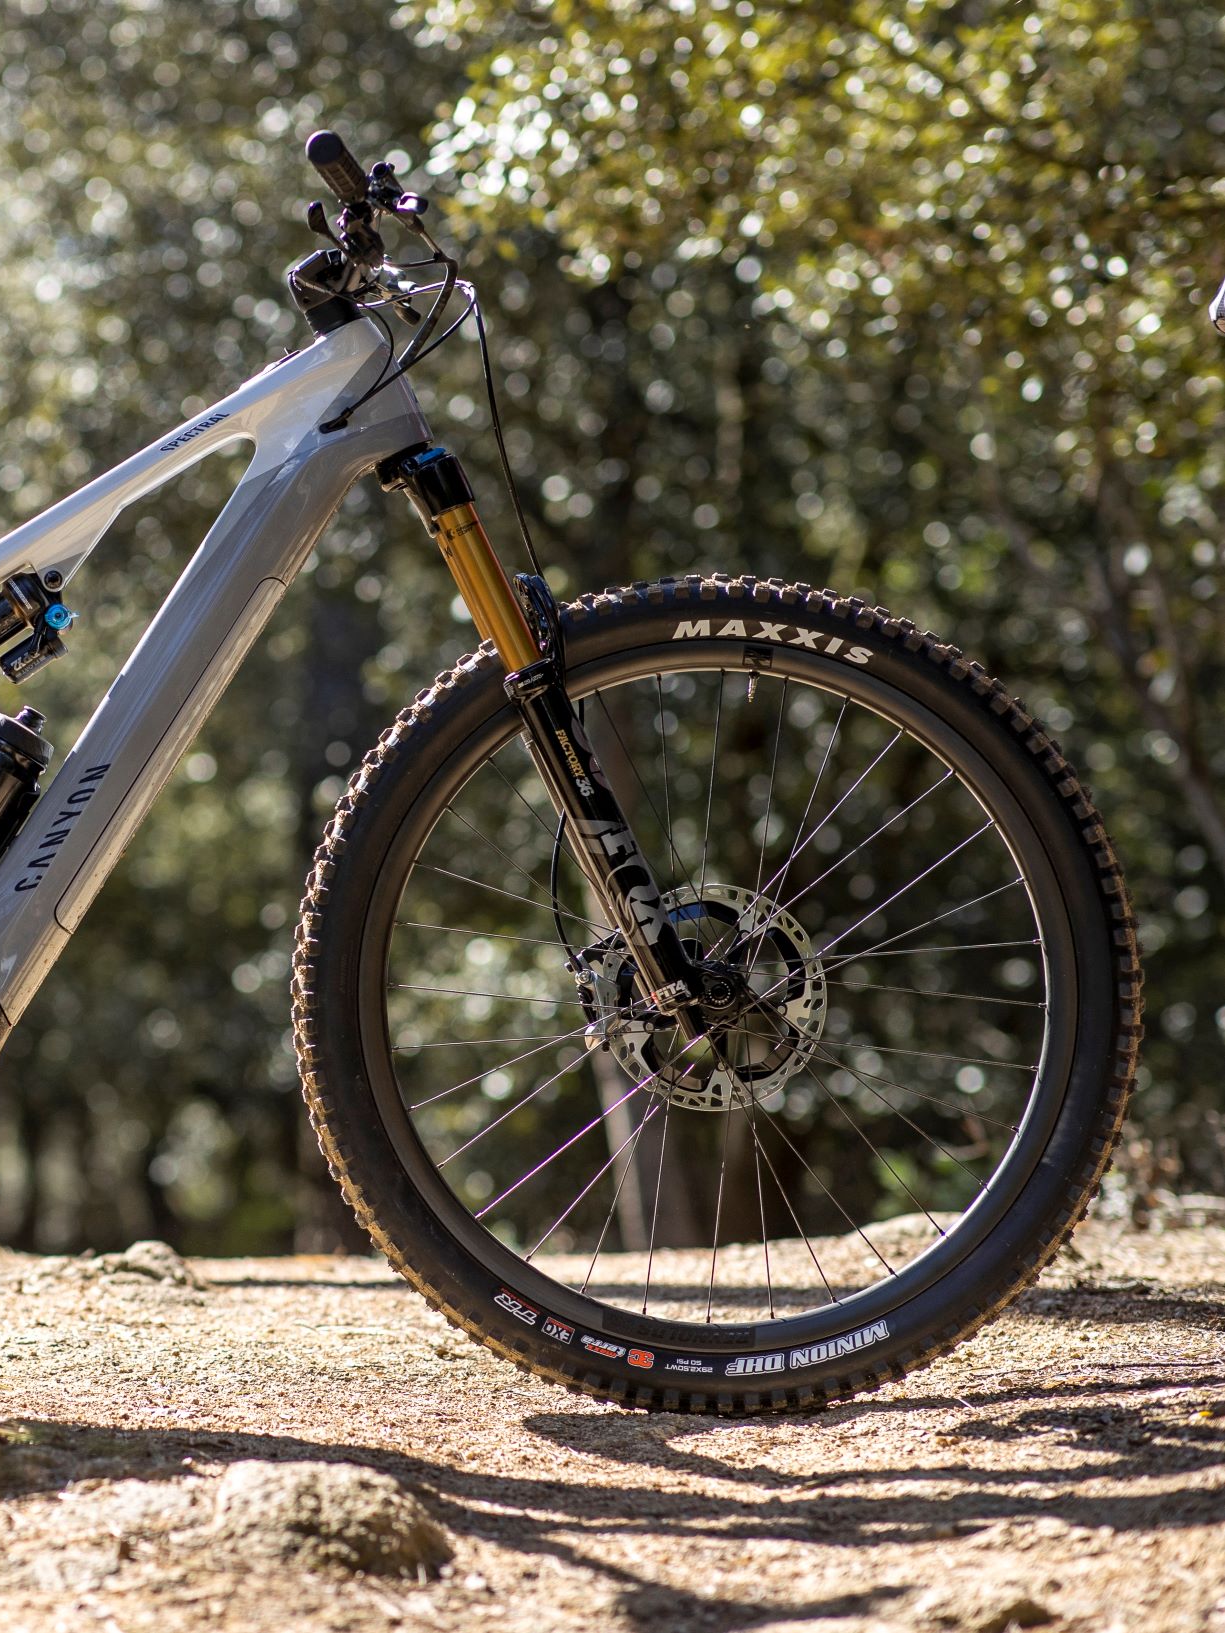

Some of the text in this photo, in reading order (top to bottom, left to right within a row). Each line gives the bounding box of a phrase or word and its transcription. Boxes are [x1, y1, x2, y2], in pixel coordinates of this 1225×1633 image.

[160, 412, 230, 452] SPECTRAL
[672, 619, 874, 664] MAXXIS
[554, 728, 585, 778] FACTORY
[575, 776, 595, 798] 36
[14, 763, 112, 892] CANYON
[494, 1293, 537, 1326] TR
[542, 1320, 573, 1343] EXO
[725, 1319, 888, 1377] MINION DHF
[627, 1348, 655, 1369] 3C
[664, 1362, 714, 1373] 29X2.50WT
[676, 1358, 703, 1366] 50 PSI
